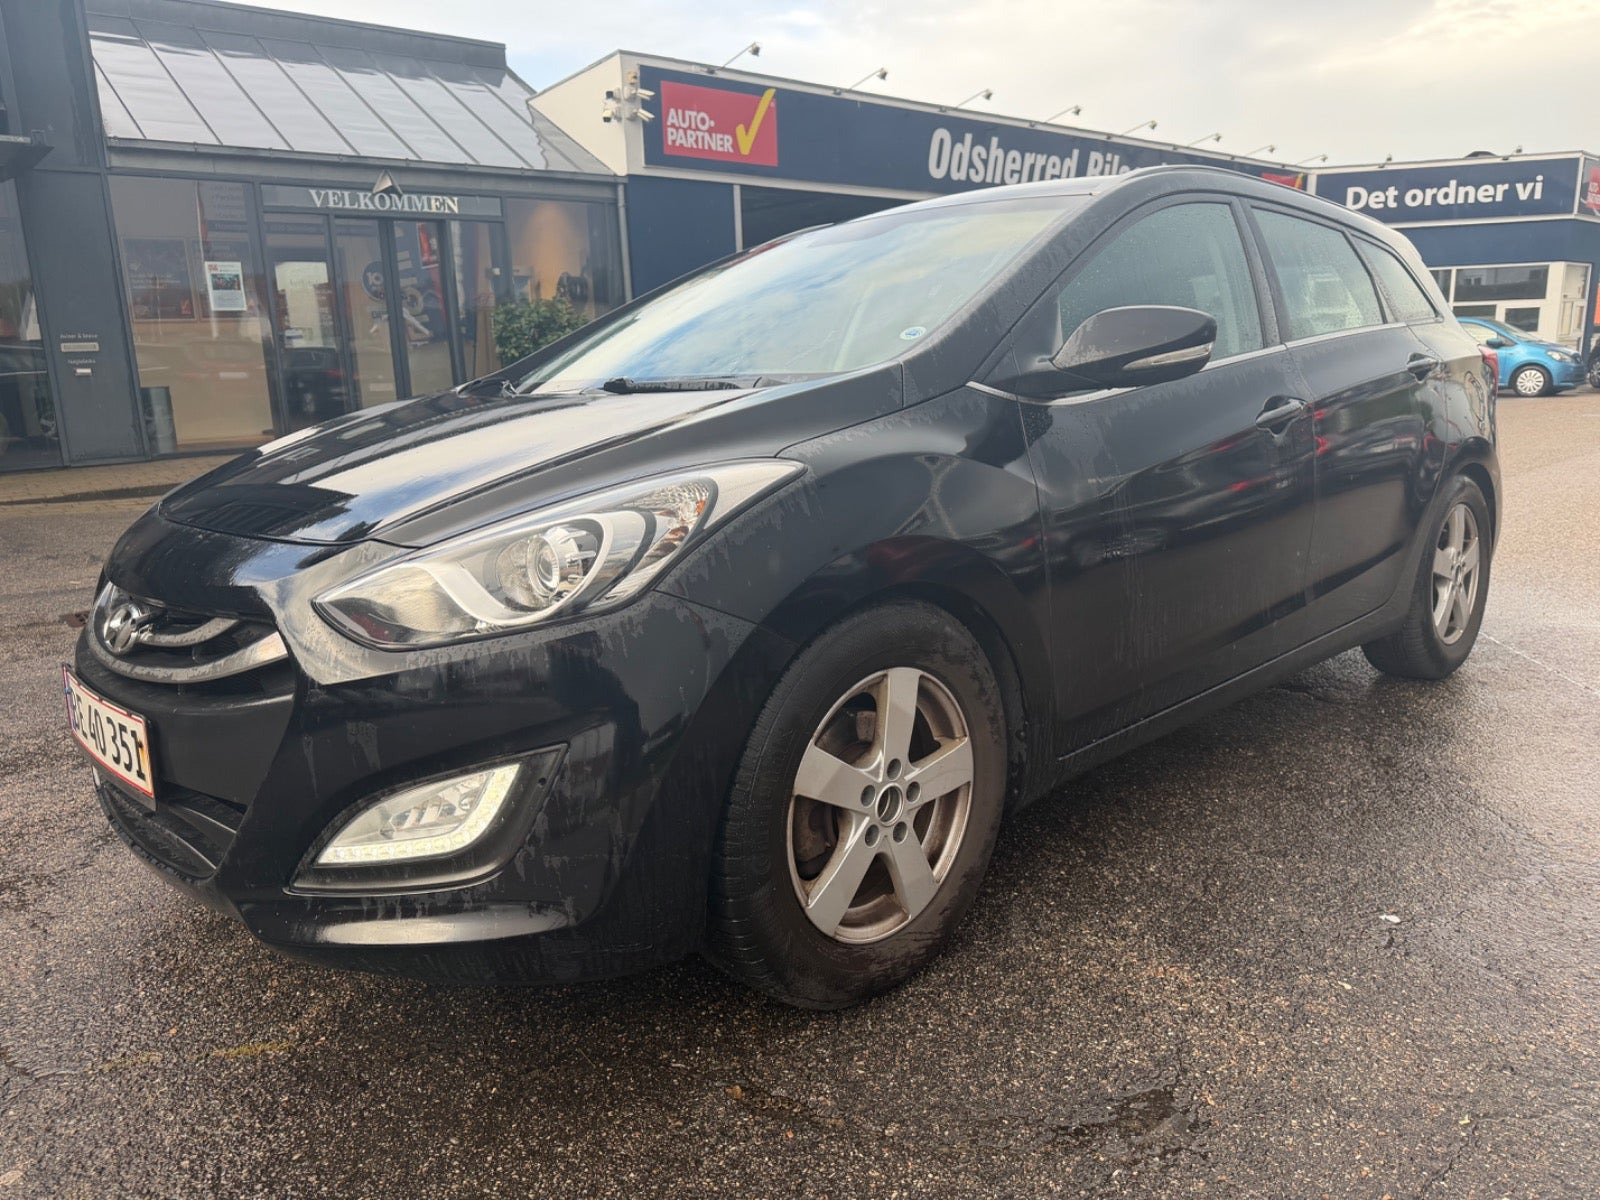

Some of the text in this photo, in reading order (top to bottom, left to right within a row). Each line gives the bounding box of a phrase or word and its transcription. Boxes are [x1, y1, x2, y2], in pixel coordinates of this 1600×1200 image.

[667, 127, 734, 153] PARTNER
[928, 127, 1080, 184] Odsherred
[309, 189, 459, 214] VELKOMMEN
[1346, 174, 1544, 210] Det ordner vi
[88, 704, 107, 757] 40
[106, 716, 147, 781] 351
